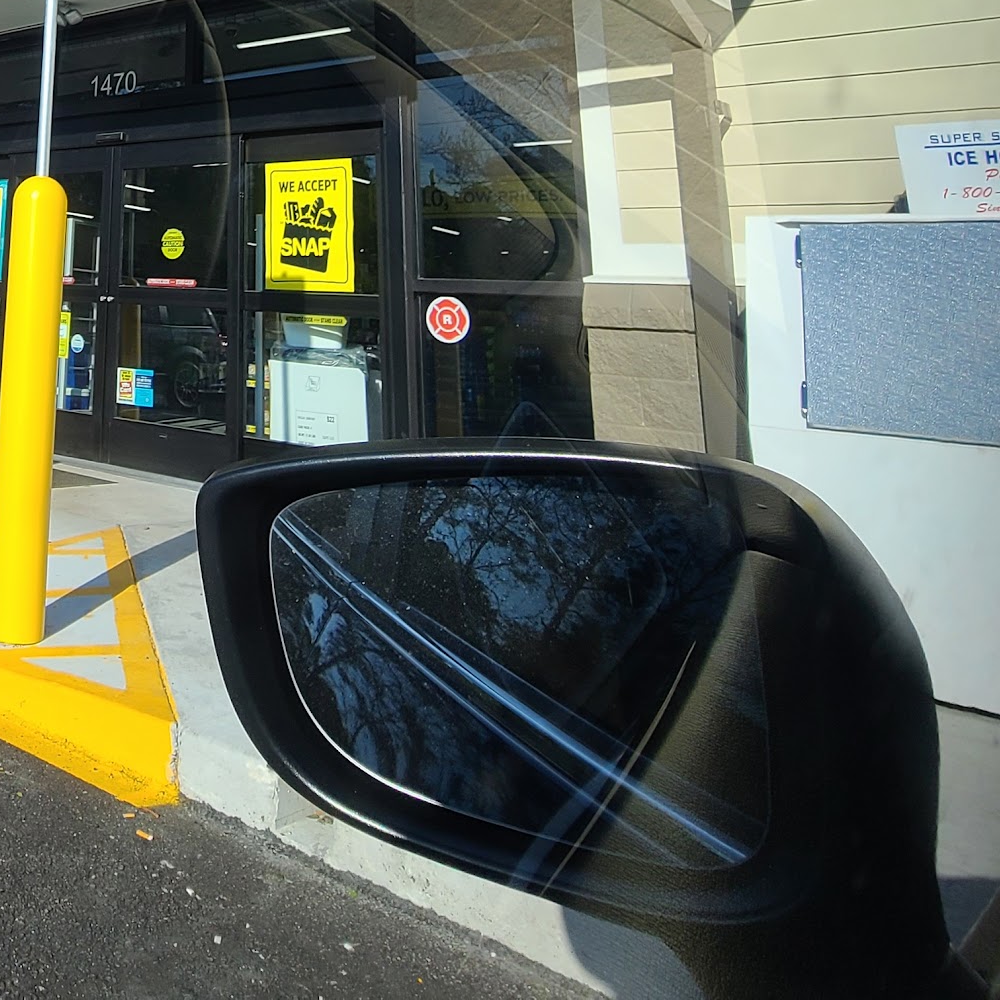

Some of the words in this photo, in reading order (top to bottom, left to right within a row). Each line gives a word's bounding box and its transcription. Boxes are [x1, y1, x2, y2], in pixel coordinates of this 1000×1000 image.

[91, 70, 137, 97] 1470
[929, 132, 982, 144] SUPER
[947, 151, 979, 166] ICE
[985, 149, 1000, 165] H
[278, 181, 296, 193] WE
[297, 179, 338, 193] ACCEPT
[280, 237, 332, 257] SNAP
[442, 314, 453, 325] R
